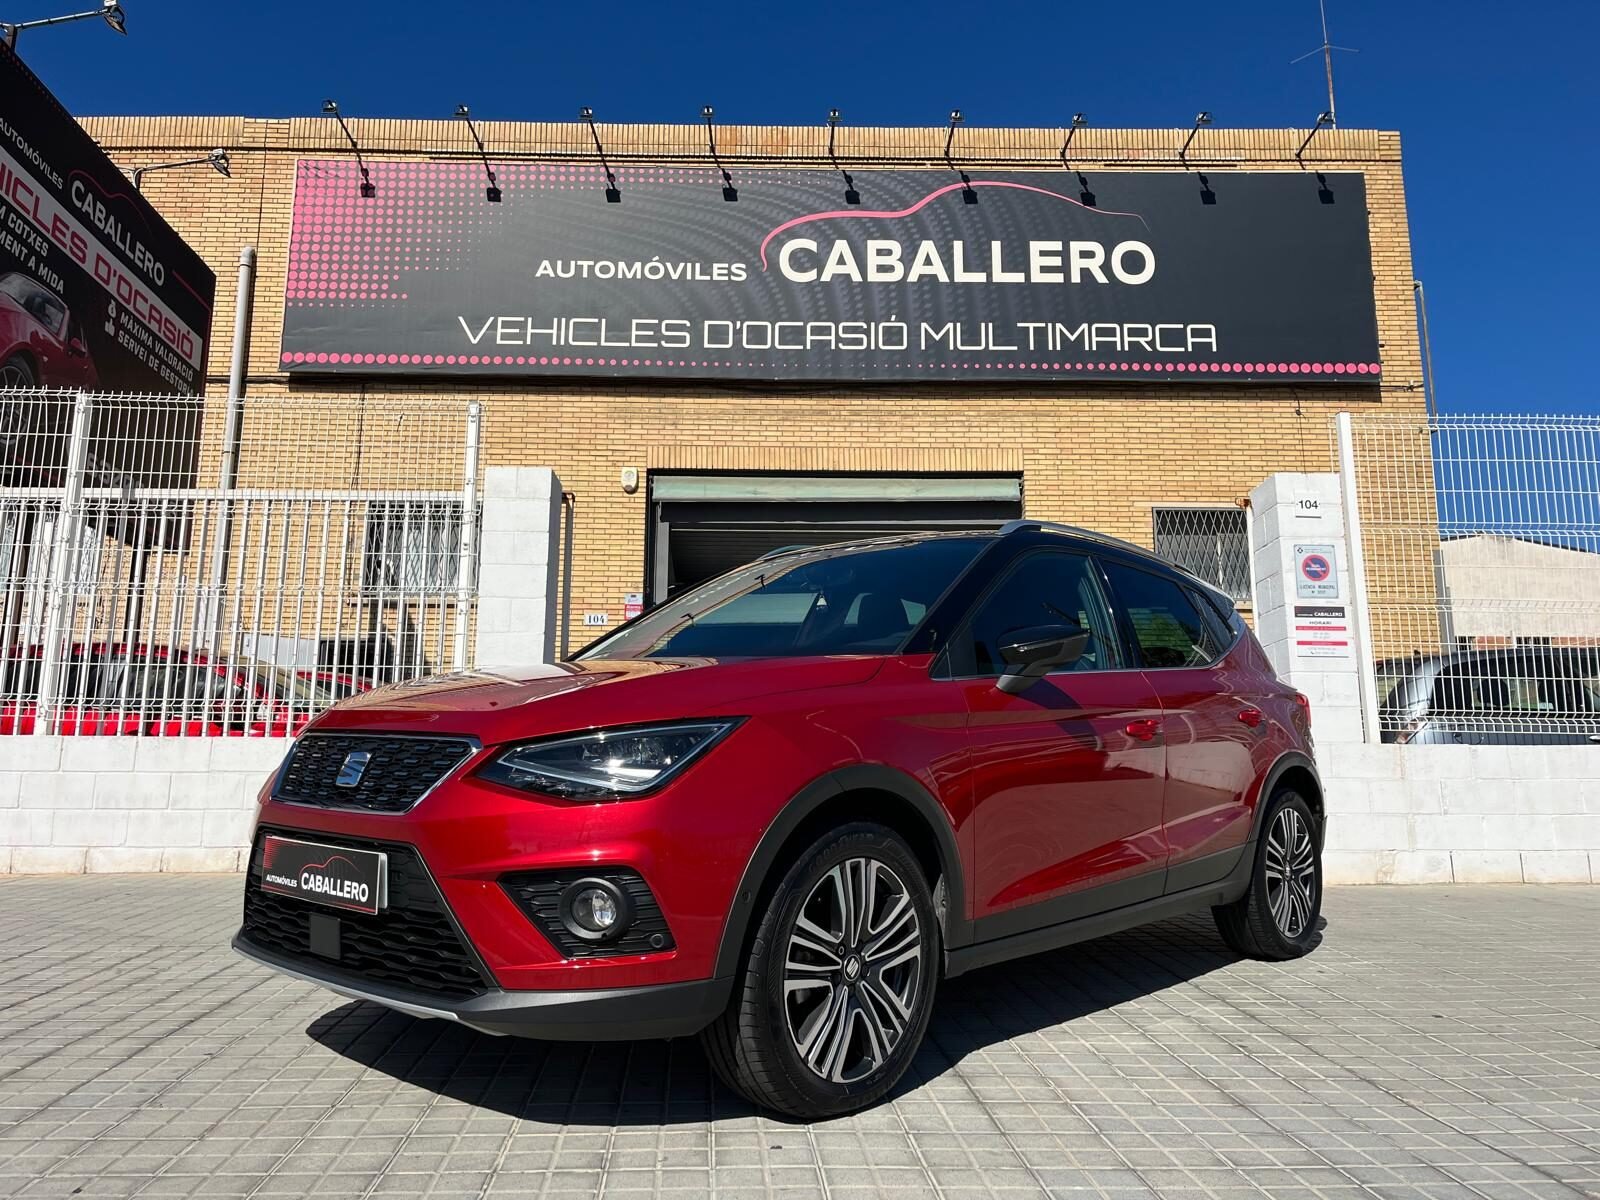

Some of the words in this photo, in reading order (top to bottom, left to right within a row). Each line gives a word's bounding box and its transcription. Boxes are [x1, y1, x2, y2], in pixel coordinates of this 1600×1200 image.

[7, 212, 49, 257] COTXES
[71, 179, 165, 287] CABALLERO
[28, 255, 36, 271] A
[38, 263, 64, 294] MIDA
[535, 255, 747, 281] AUTOMÓVILES
[778, 237, 1156, 286] CABALLERO
[94, 252, 194, 361] D'OCASIÓ
[118, 330, 148, 362] SERVEI
[148, 355, 160, 372] DE
[457, 316, 691, 348] VEHICLES
[703, 314, 908, 350] D'OCASIÓ
[920, 322, 1217, 352] MULTIMARCA
[154, 340, 194, 382] VALORACIÓ
[1298, 499, 1319, 509] 104
[588, 615, 605, 624] 104
[266, 873, 298, 888] AUTOMÓVILES
[301, 872, 369, 903] CABALLERO
